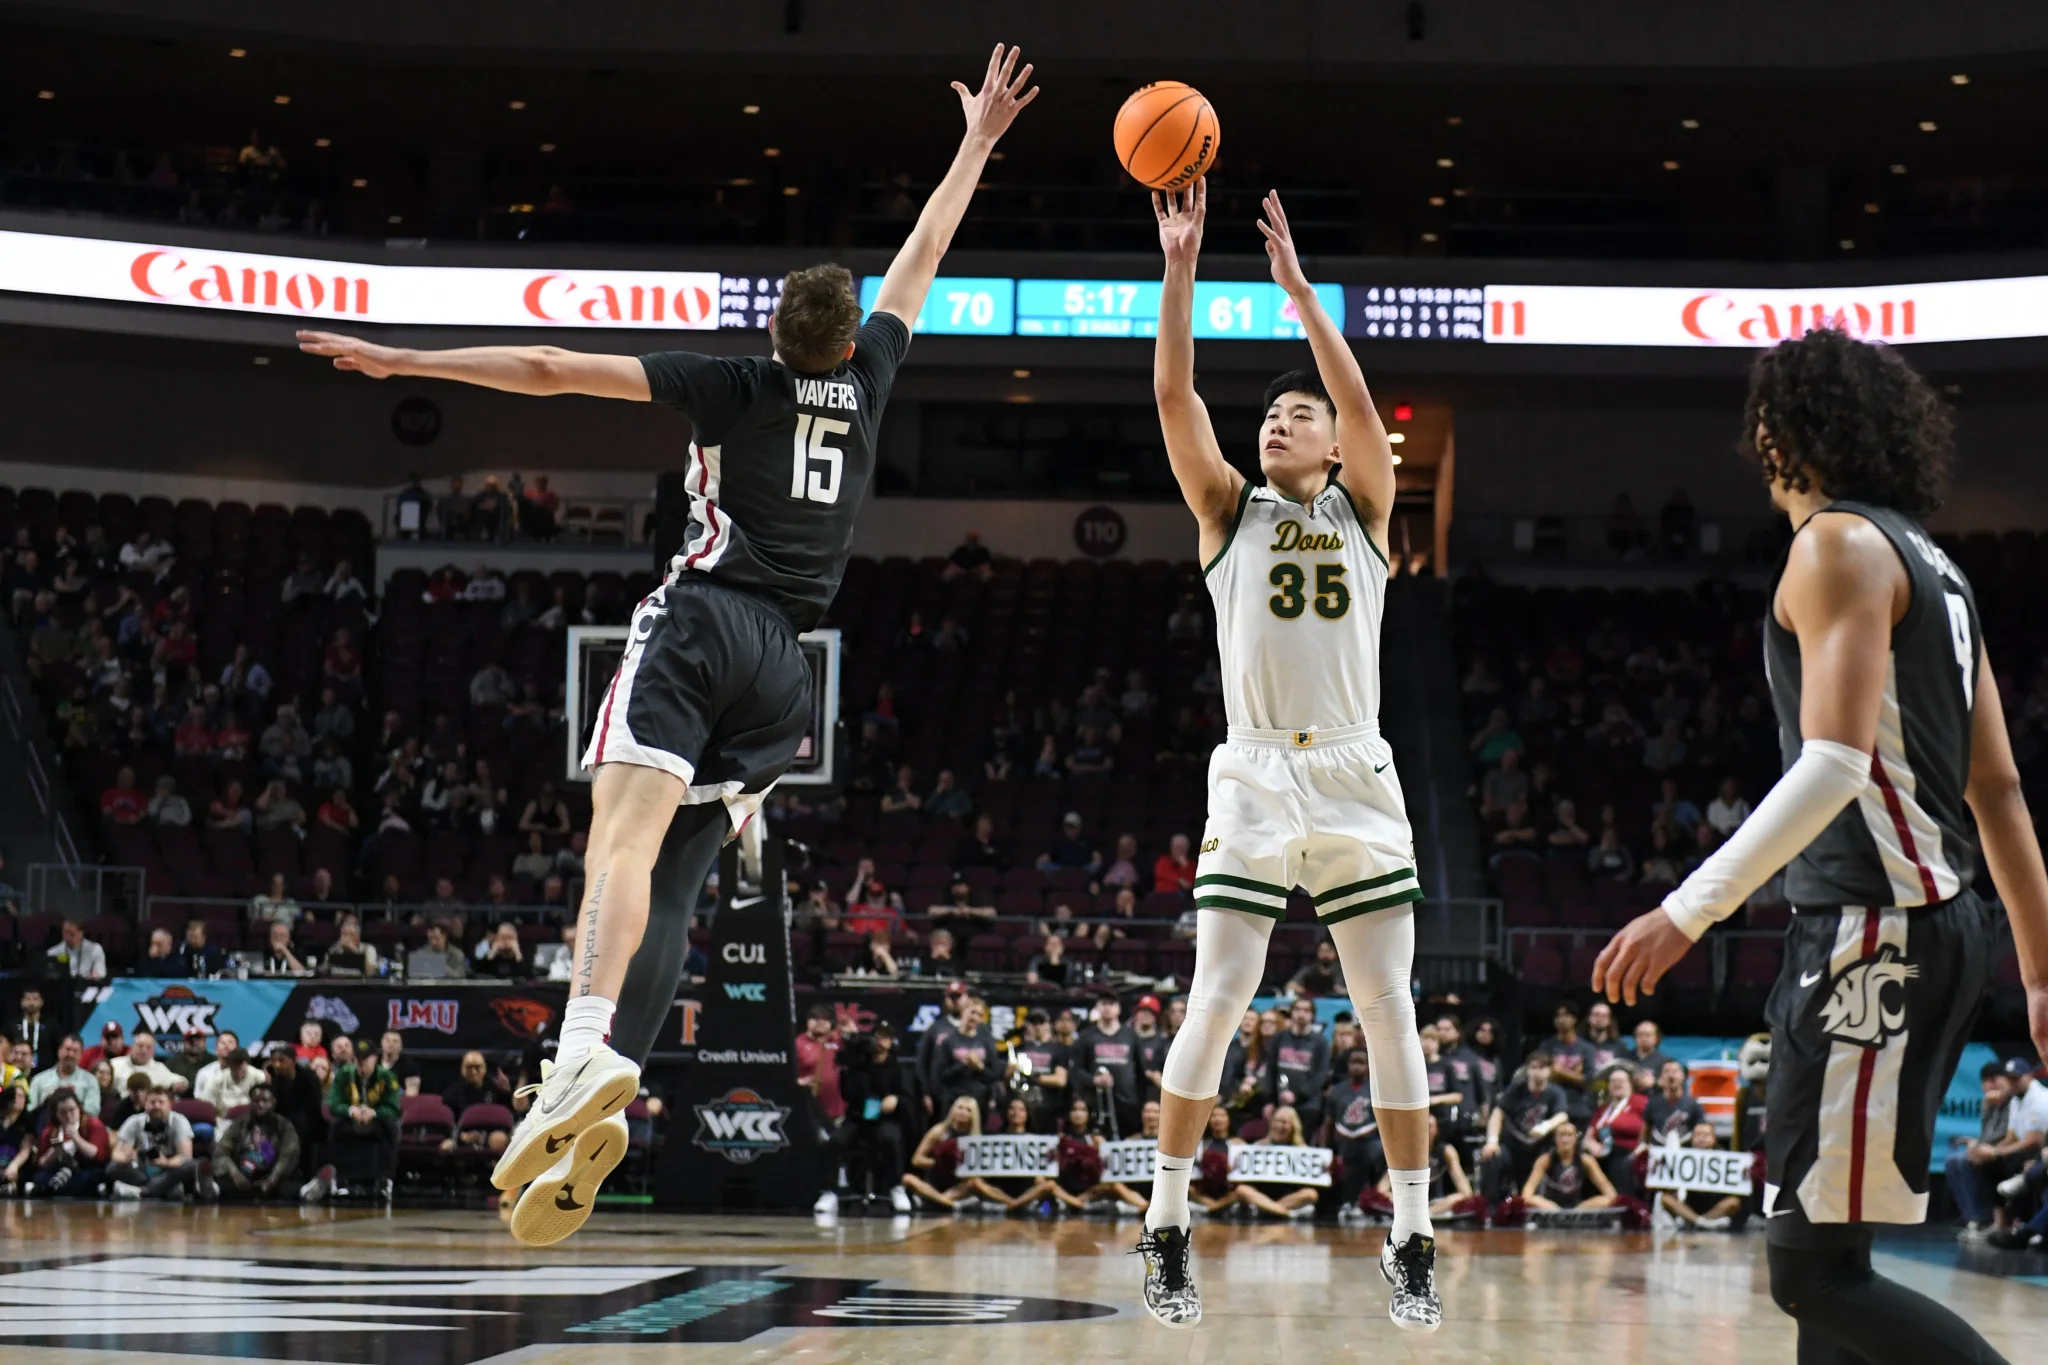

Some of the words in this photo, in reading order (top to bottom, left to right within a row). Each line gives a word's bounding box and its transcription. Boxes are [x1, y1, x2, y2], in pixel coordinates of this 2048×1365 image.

[1162, 135, 1212, 188] Wilson
[130, 251, 369, 314] Canon
[946, 291, 994, 327] 70
[1064, 284, 1137, 315] 5:17
[1208, 296, 1252, 331] 61
[1682, 295, 1914, 339] Canon
[795, 378, 858, 411] VAVERS
[791, 413, 851, 504] 15
[1082, 520, 1119, 543] 110
[1270, 519, 1344, 552] Dons
[1269, 562, 1351, 621] 35
[585, 908, 598, 927] ad
[578, 929, 599, 978] Aspera
[722, 942, 766, 964] CU1
[579, 983, 591, 997] er
[723, 983, 766, 1001] WCC
[138, 1004, 217, 1036] WCC
[388, 999, 459, 1035] LMU
[697, 1049, 738, 1063] Credit
[740, 1050, 780, 1064] Union
[702, 1110, 782, 1141] WCC
[965, 1141, 1048, 1171] DEFENSE
[1109, 1146, 1157, 1176] DEFE
[1238, 1150, 1321, 1178] DEFENSE
[1659, 1153, 1740, 1186] NOISE
